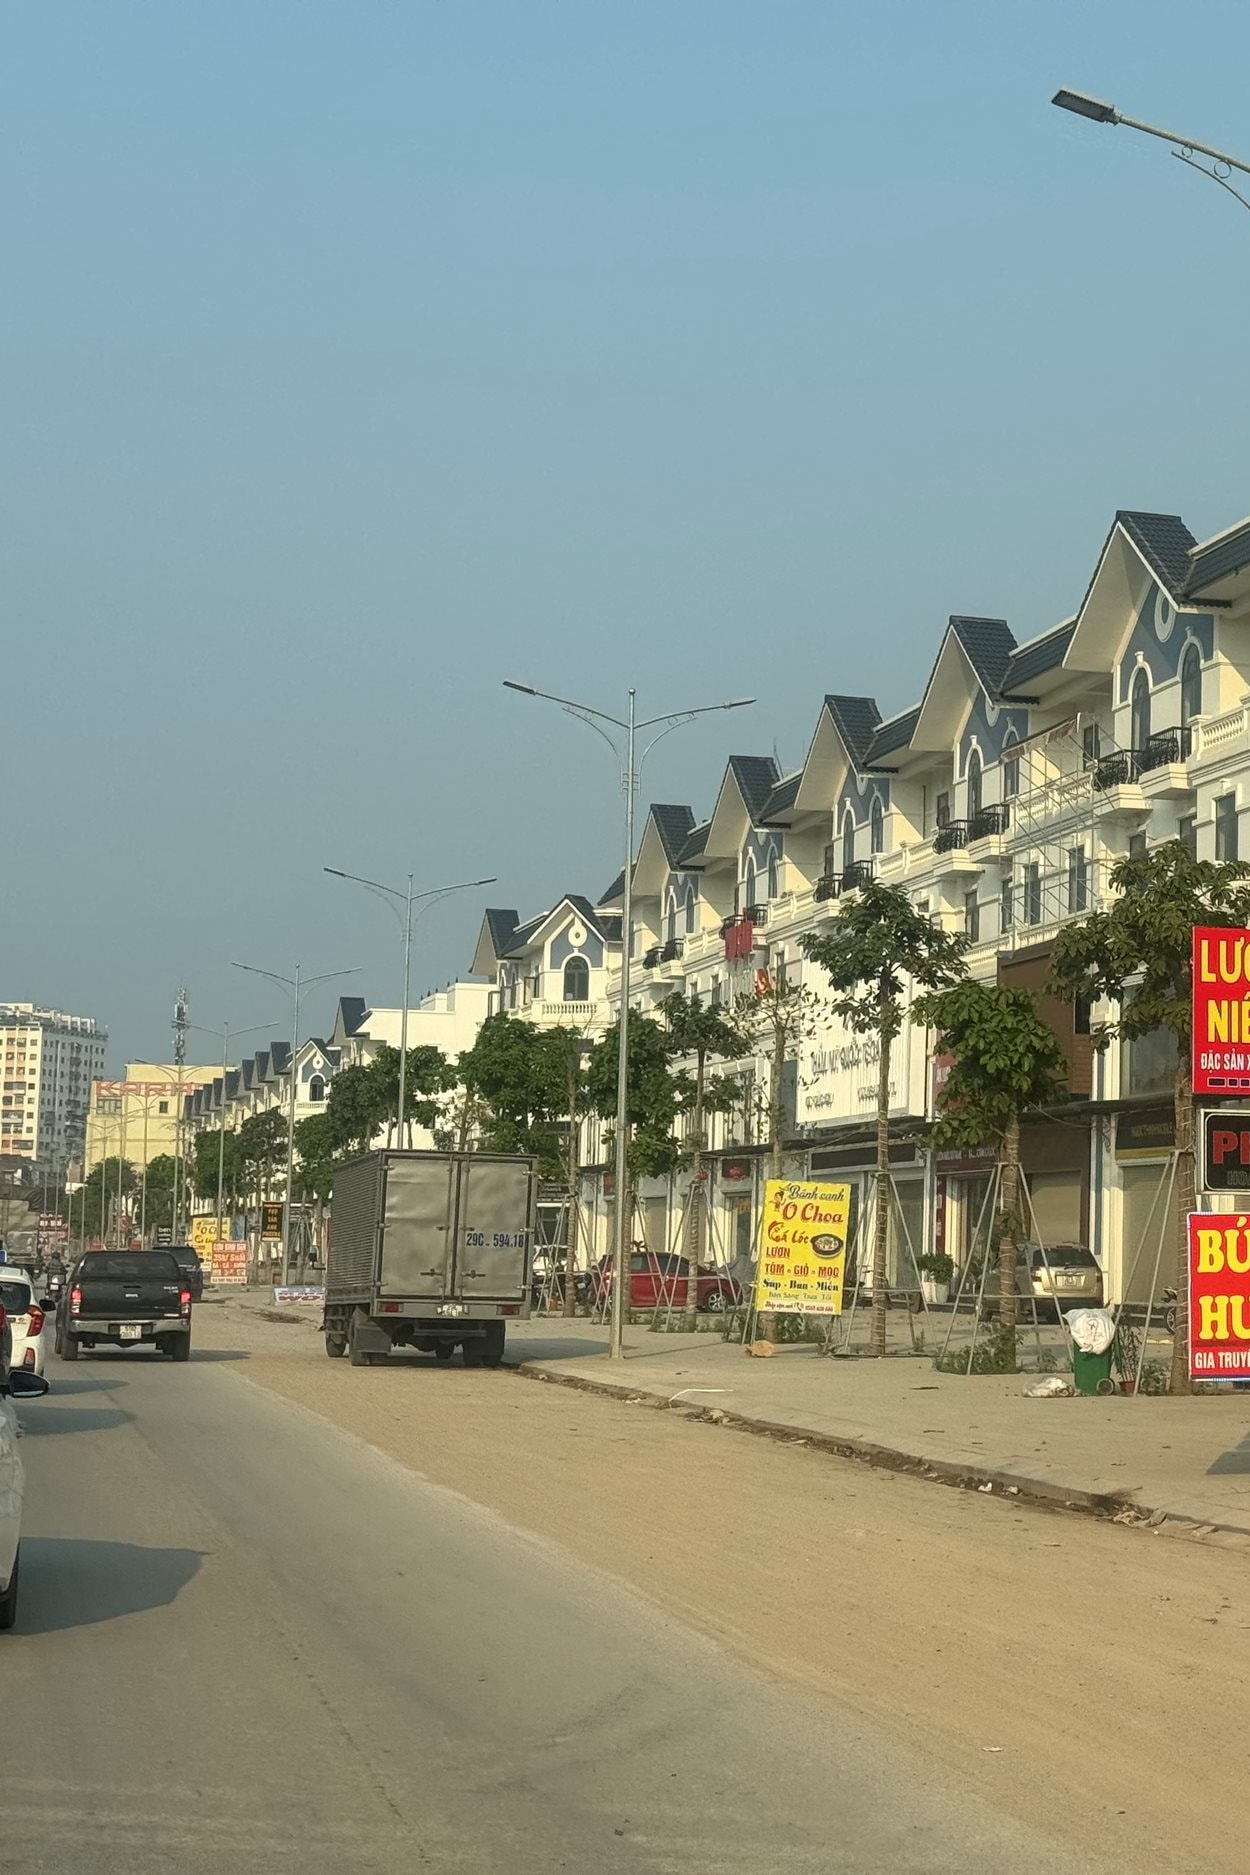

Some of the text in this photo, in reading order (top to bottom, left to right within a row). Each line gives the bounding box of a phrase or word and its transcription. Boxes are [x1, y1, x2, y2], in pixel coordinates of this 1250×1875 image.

[1201, 1050, 1221, 1073] ĐẶC
[1224, 1048, 1244, 1071] SẢN
[788, 1184, 844, 1201] Bánh canh
[782, 1201, 844, 1223] O Choa
[466, 1232, 484, 1246] 29C
[493, 1234, 524, 1248] 594.18
[768, 1220, 809, 1244] Cá Lóc
[766, 1246, 790, 1258] LƯƠN
[1195, 1351, 1215, 1369] GIA
